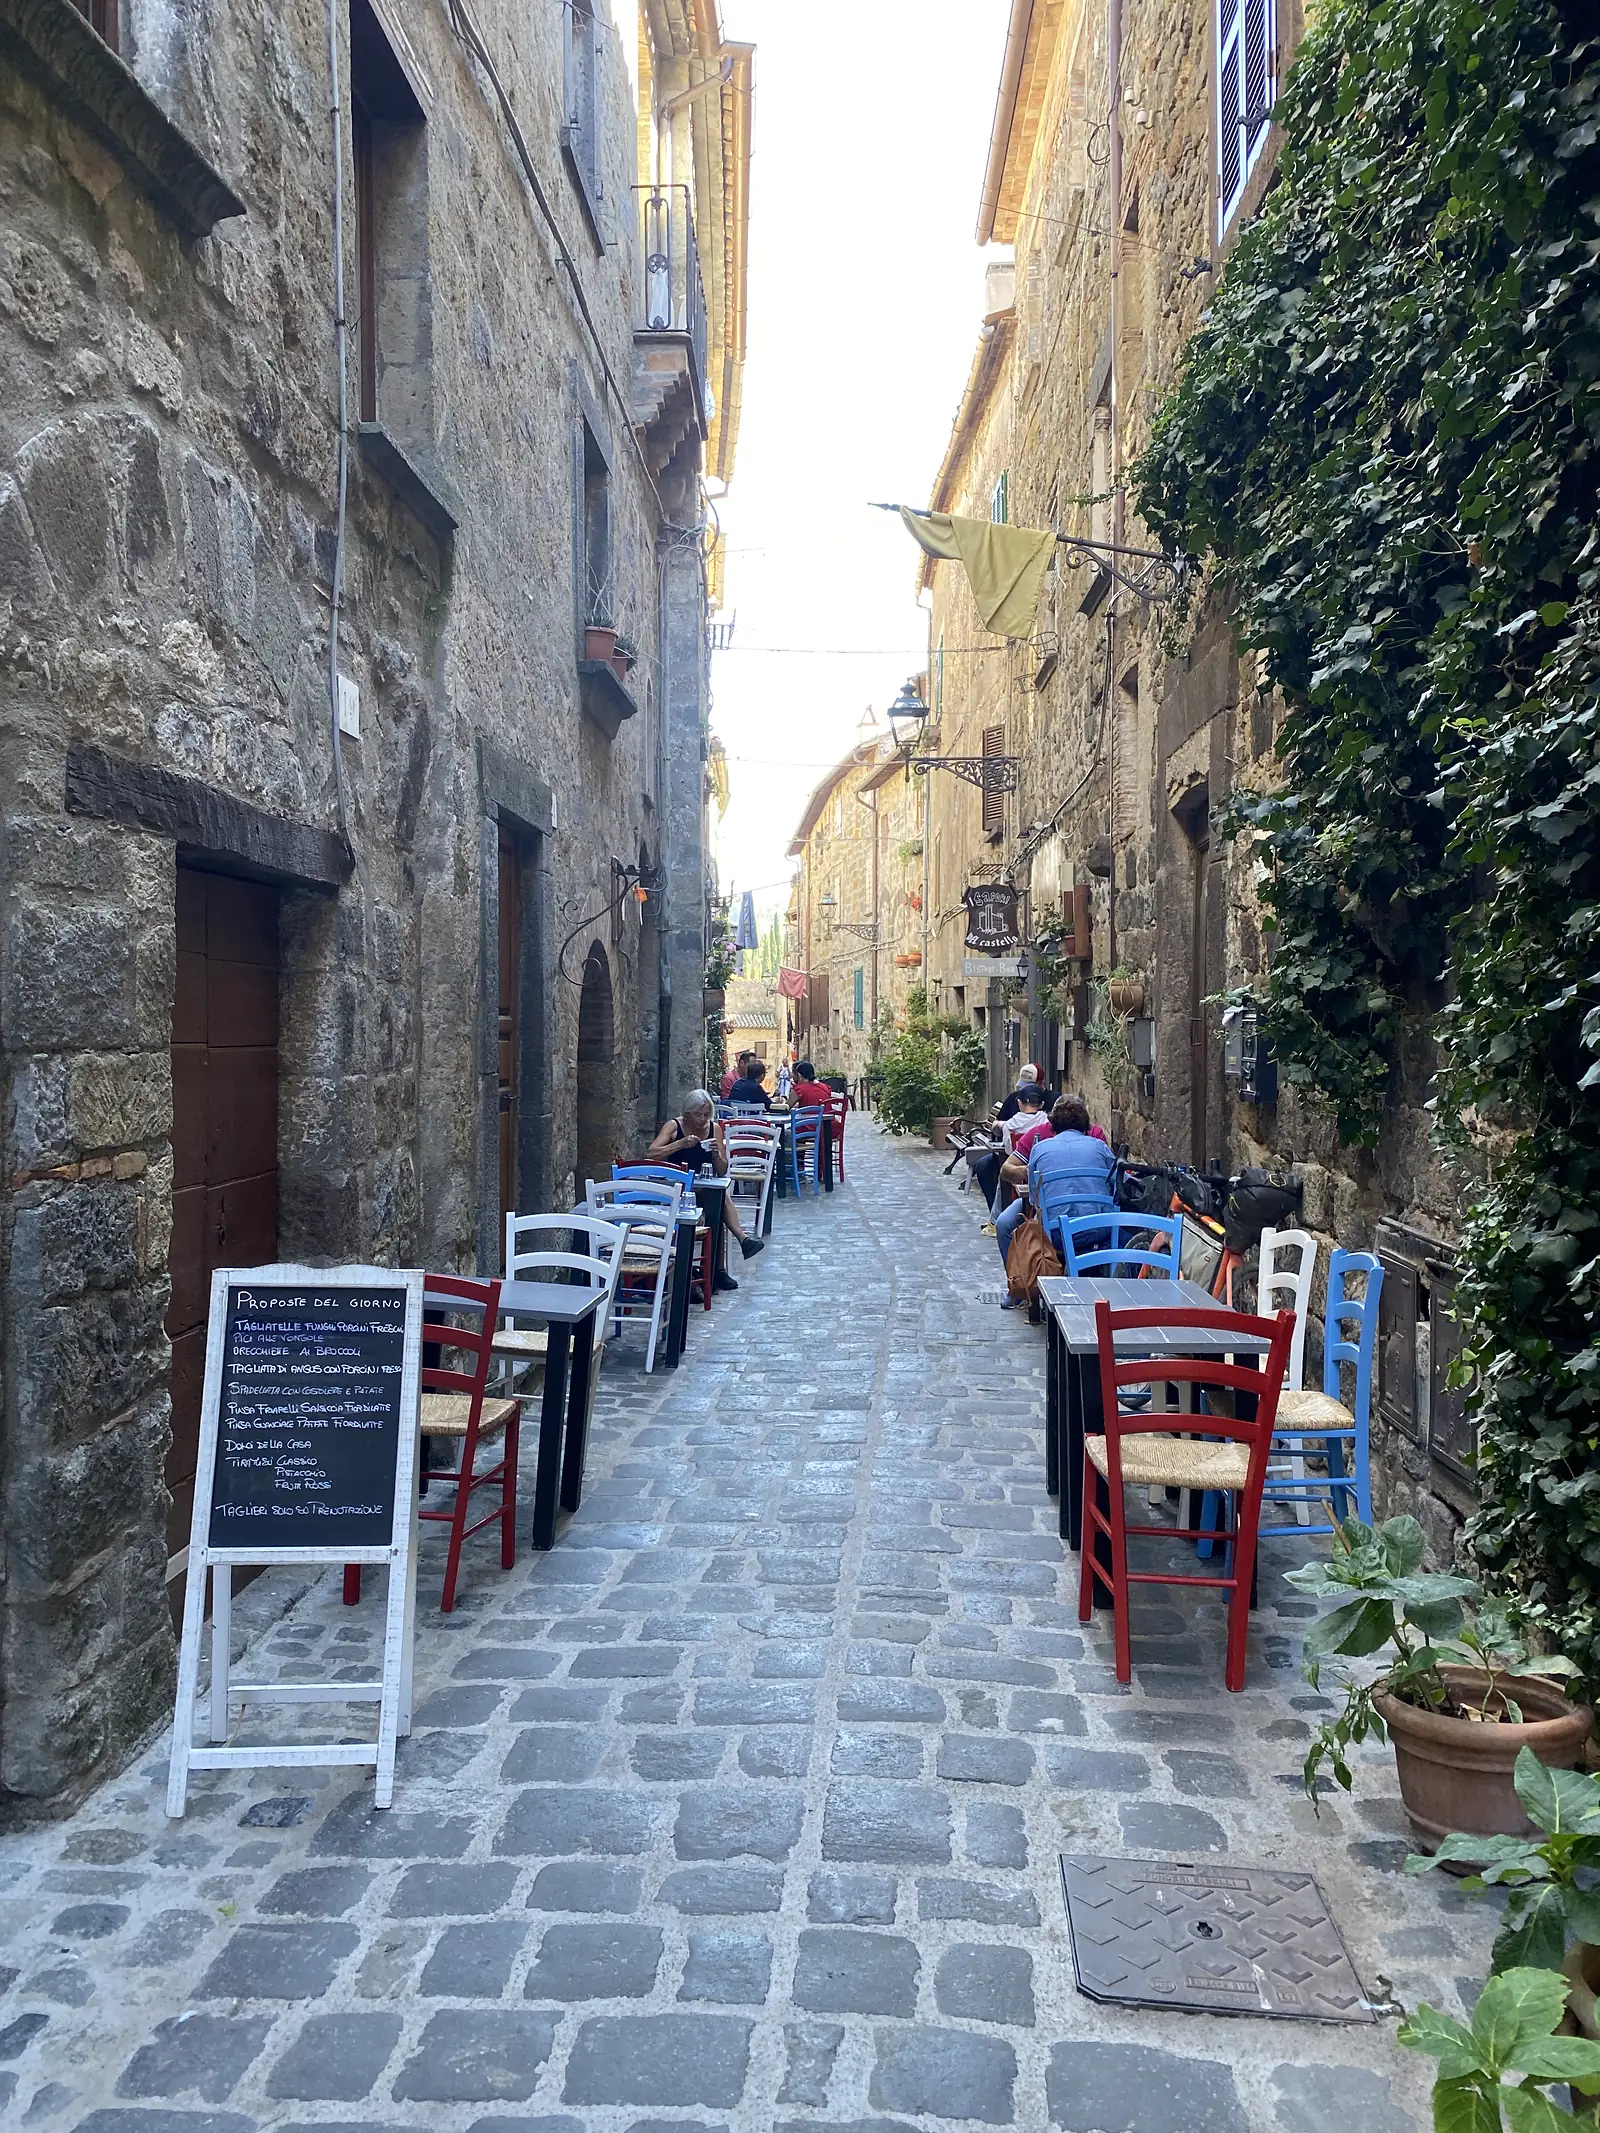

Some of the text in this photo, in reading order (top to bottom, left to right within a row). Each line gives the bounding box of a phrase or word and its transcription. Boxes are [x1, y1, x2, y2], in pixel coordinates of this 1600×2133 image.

[979, 936, 1018, 947] castello
[237, 1291, 401, 1310] PROPOSTE DEL GIORNO
[235, 1320, 302, 1331] TAGLIATELLE
[280, 1334, 324, 1342] VONGOLE
[290, 1364, 322, 1374] ANGUS
[324, 1364, 340, 1374] CON
[341, 1364, 380, 1374] PORCINI
[282, 1386, 300, 1396] CON
[354, 1386, 384, 1394] PATATE
[296, 1416, 328, 1428] PATATE
[287, 1438, 312, 1450] CASA
